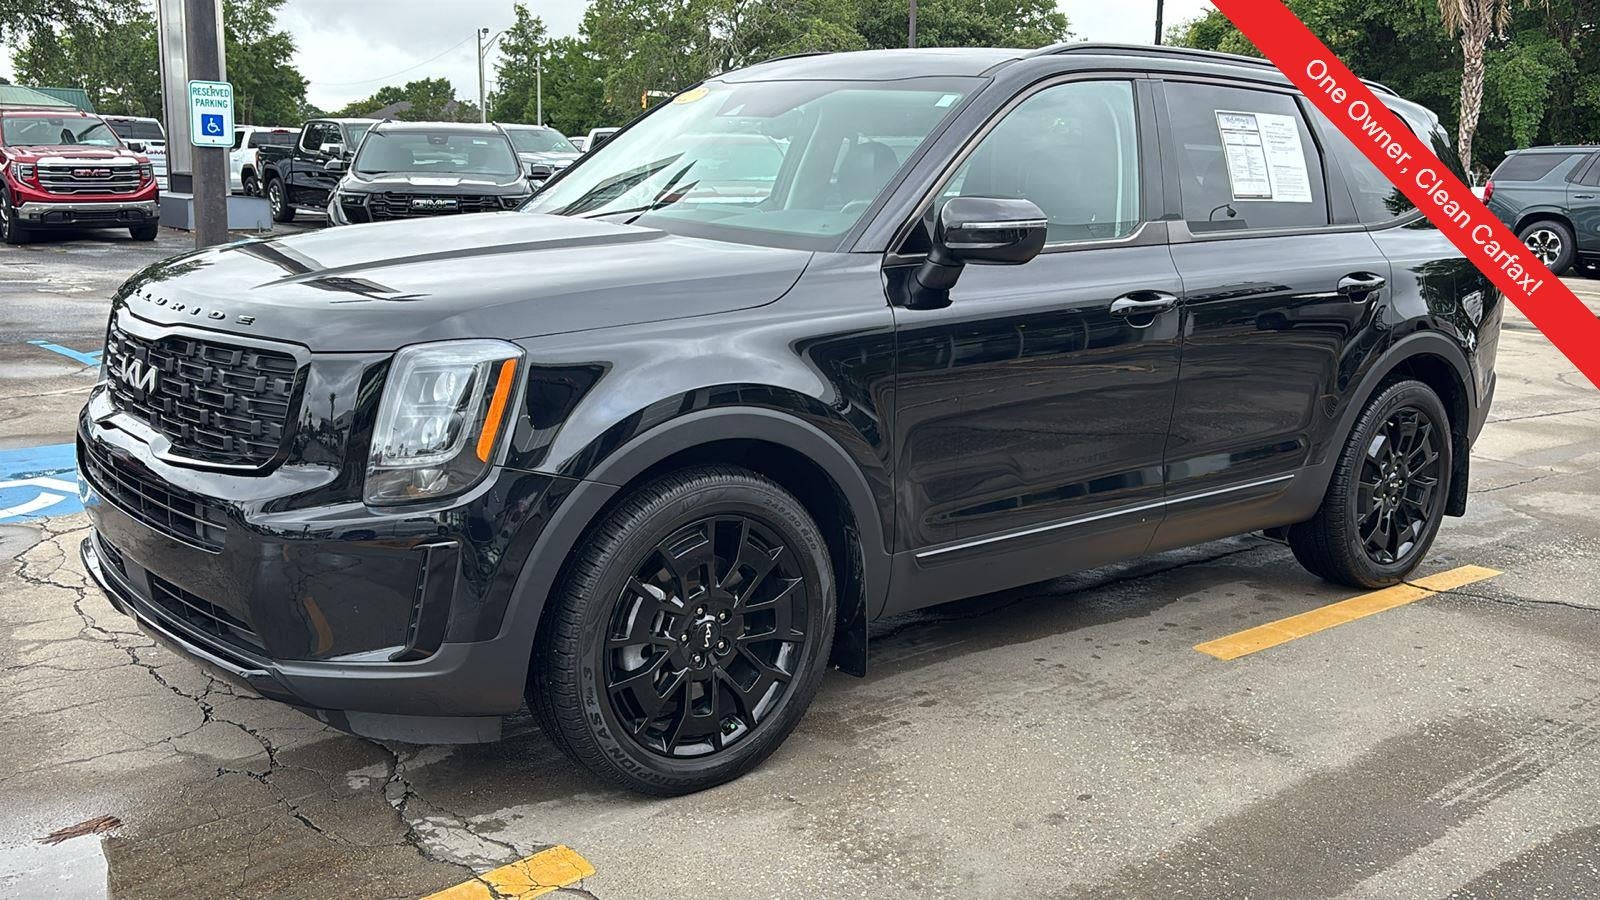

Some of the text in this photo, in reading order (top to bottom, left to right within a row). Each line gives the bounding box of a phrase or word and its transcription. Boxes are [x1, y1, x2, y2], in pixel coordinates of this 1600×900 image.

[192, 87, 230, 98] RESERVED
[195, 98, 228, 109] PARKING
[73, 168, 112, 177] GMC
[412, 199, 457, 209] GMC
[120, 353, 158, 395] KIA
